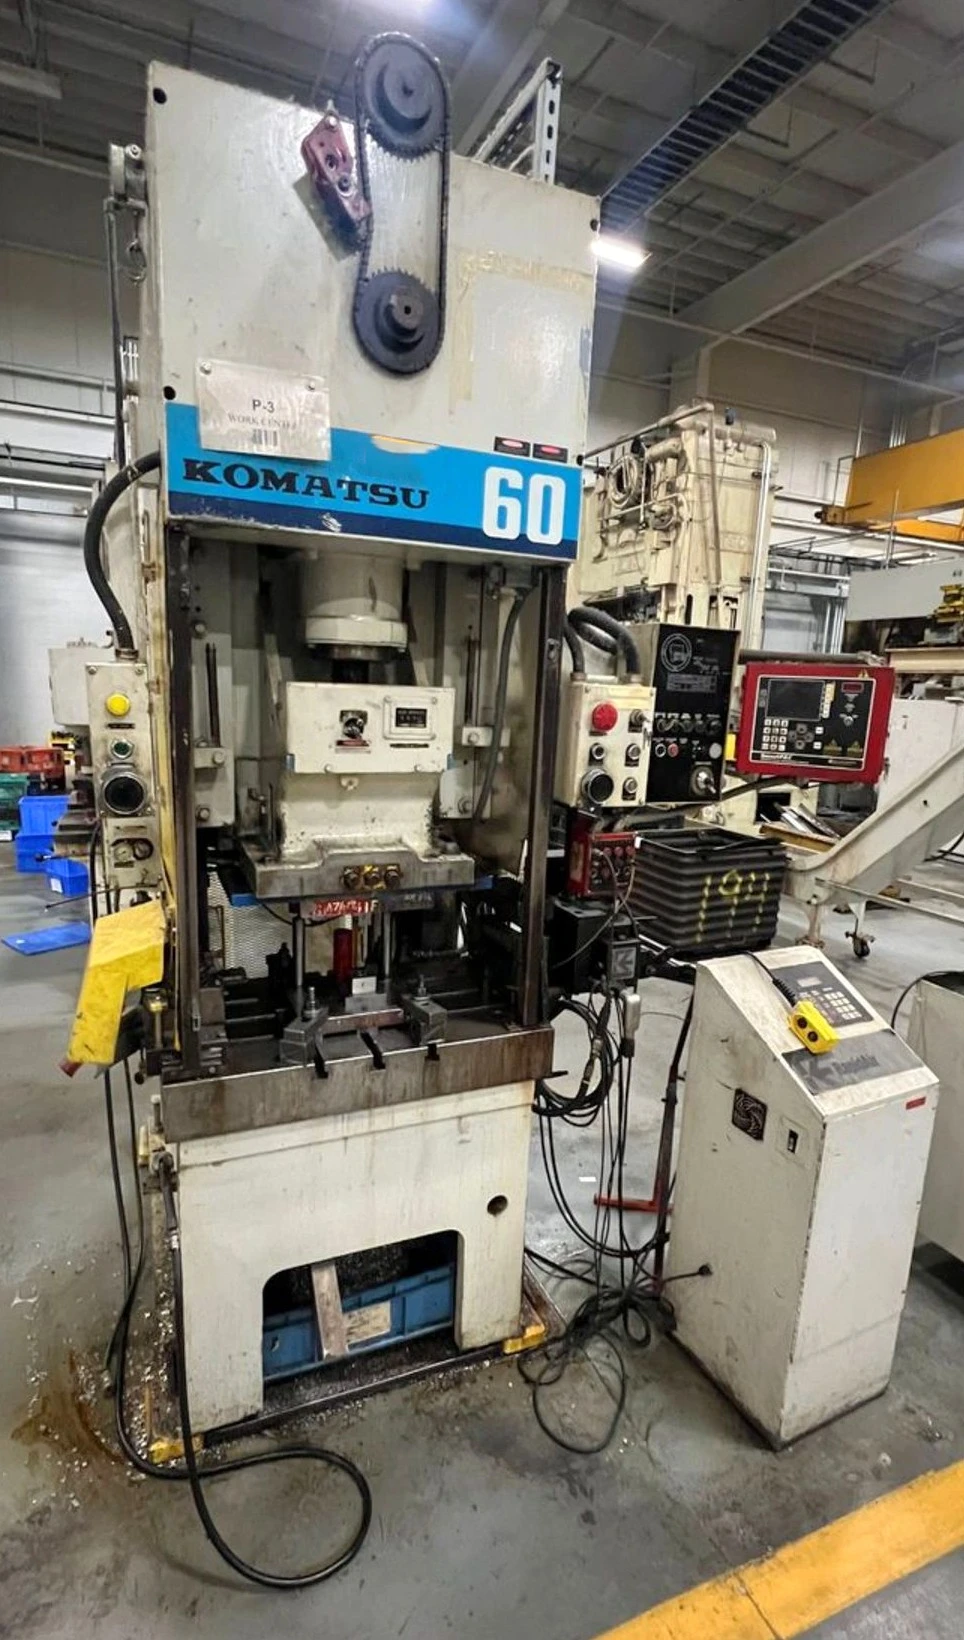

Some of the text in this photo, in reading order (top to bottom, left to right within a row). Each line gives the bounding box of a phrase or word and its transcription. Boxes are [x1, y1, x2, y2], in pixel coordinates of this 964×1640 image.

[228, 413, 259, 425] WORK
[252, 399, 275, 413] P-3
[183, 459, 430, 510] KOMATSU
[482, 466, 566, 546] 60
